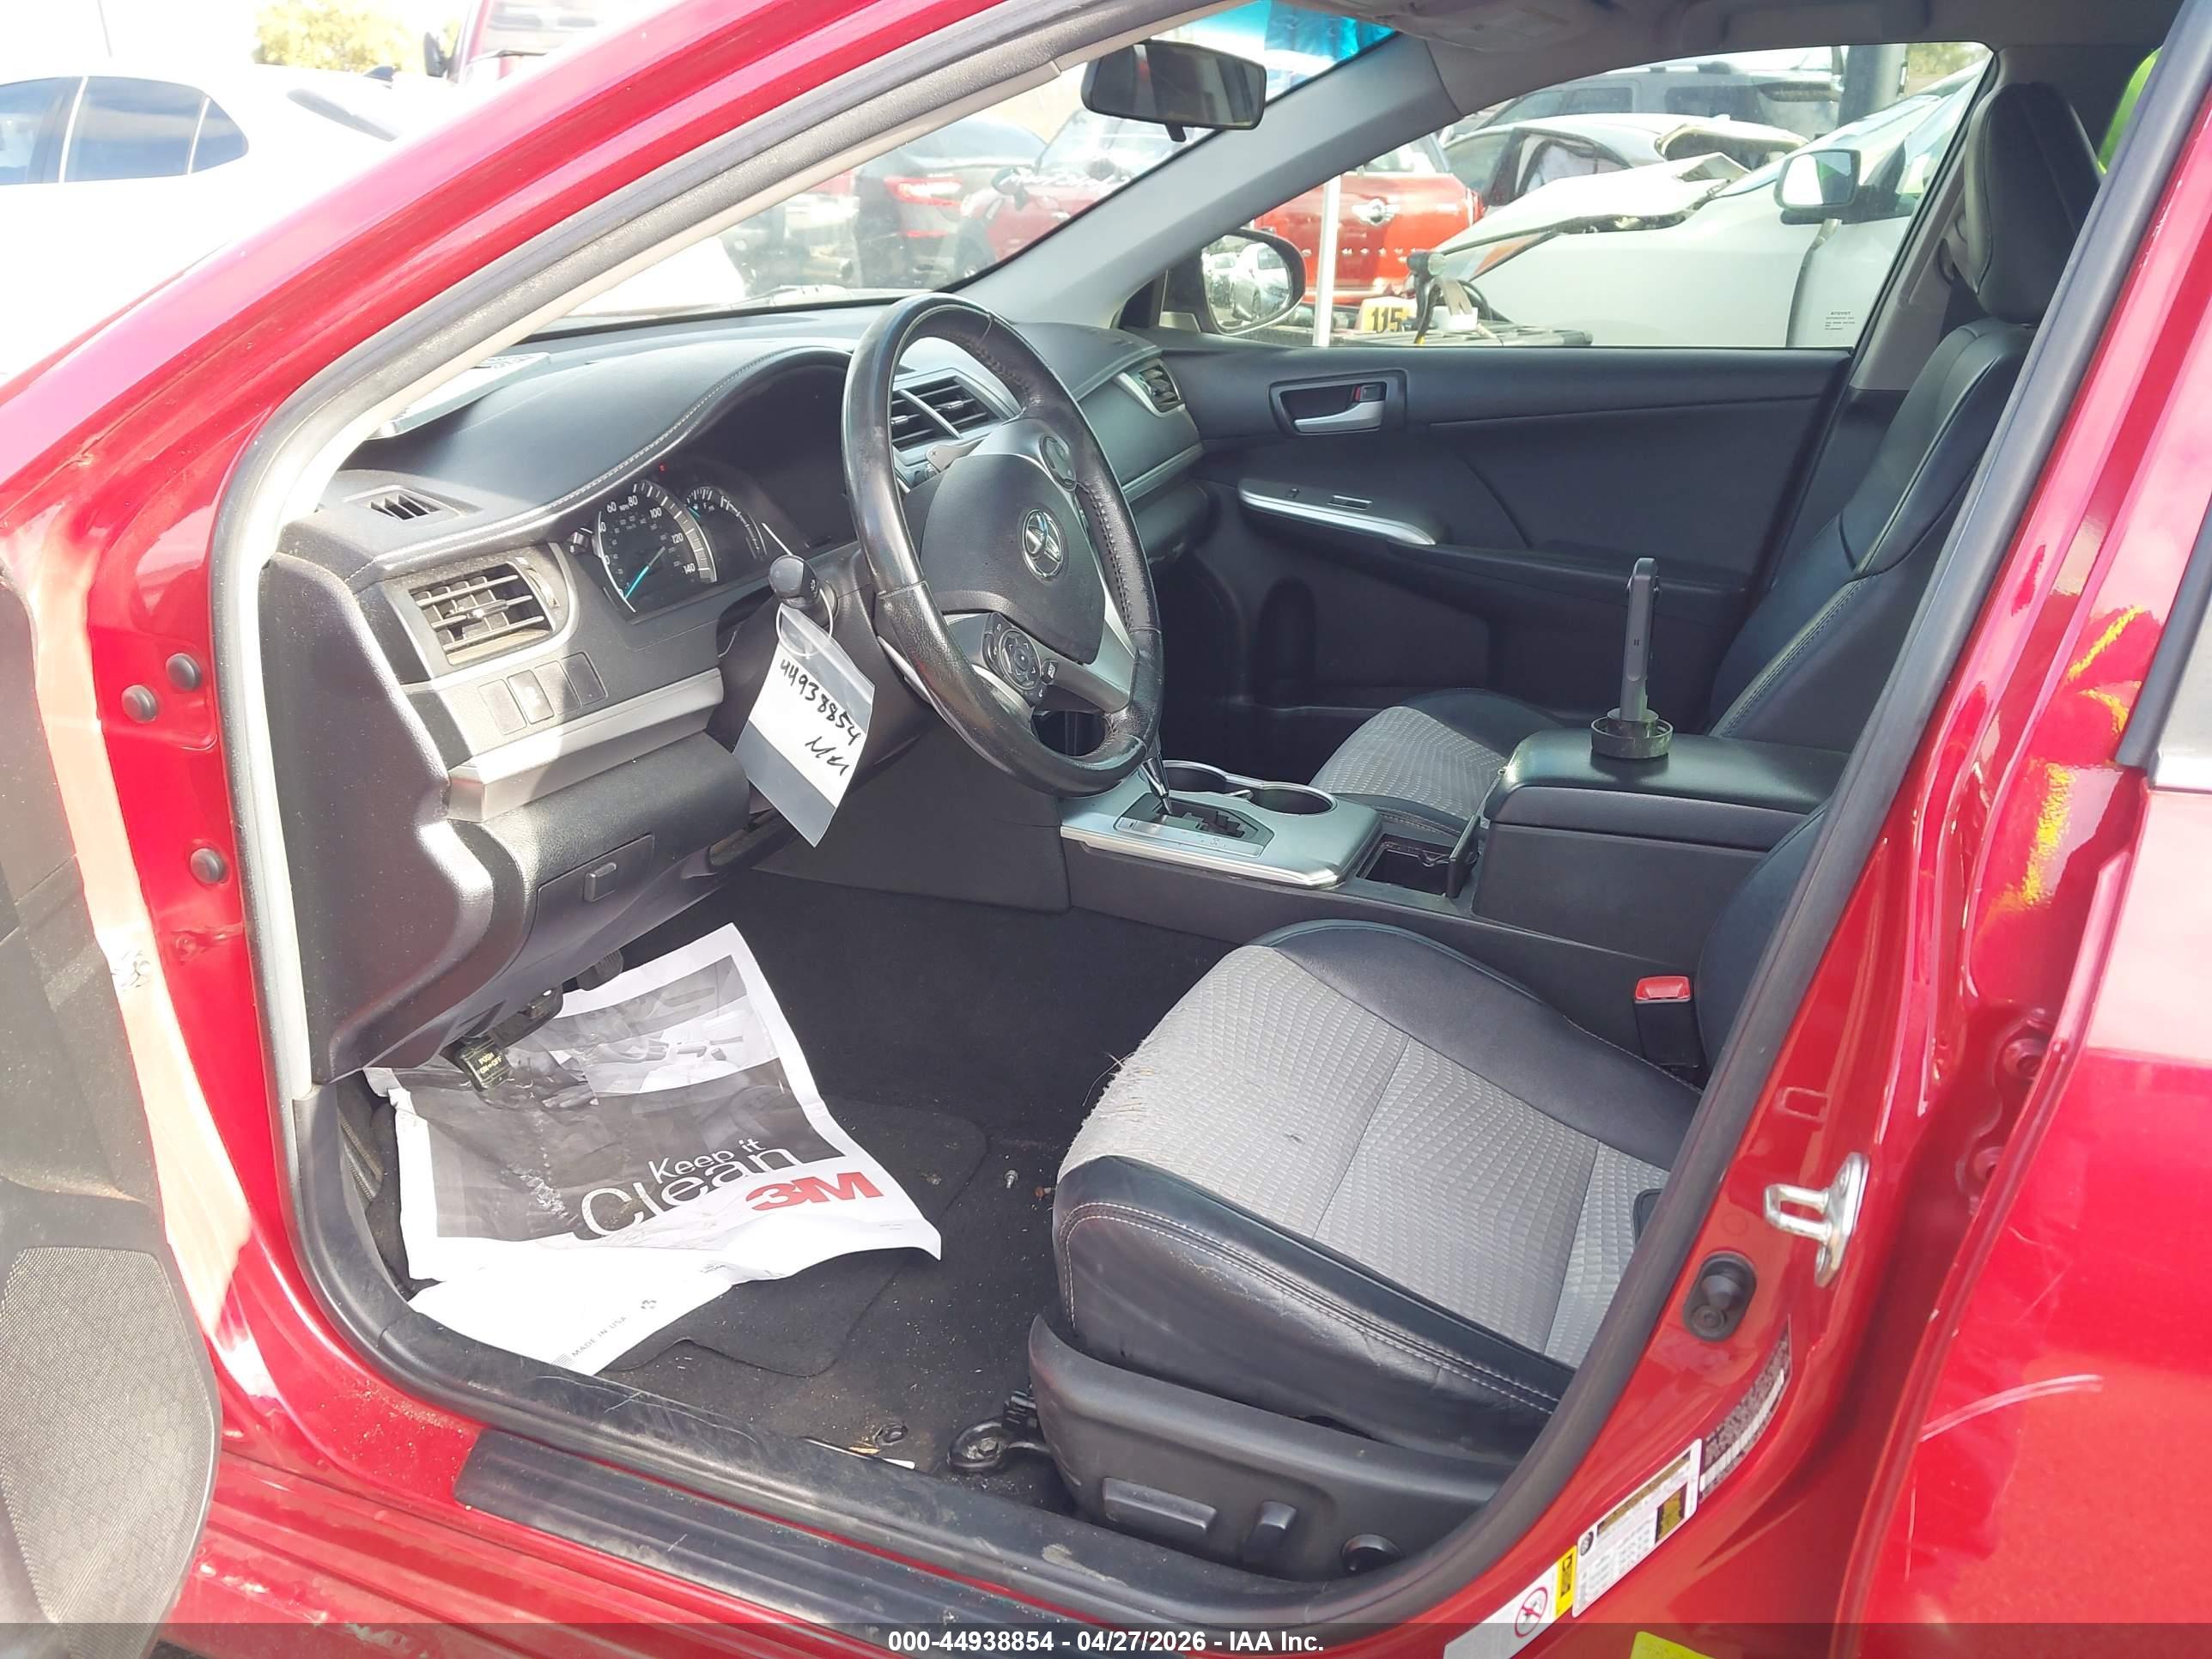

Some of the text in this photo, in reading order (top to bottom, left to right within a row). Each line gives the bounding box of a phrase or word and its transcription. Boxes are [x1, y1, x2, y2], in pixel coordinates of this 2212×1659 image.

[607, 502, 617, 513] 60
[628, 495, 638, 507] 80
[649, 507, 662, 520] 100
[672, 533, 684, 544] 120
[683, 563, 696, 574] 140
[781, 659, 861, 745] 44938854
[647, 1138, 766, 1184] Keep it
[580, 1147, 800, 1237] Clean
[745, 1171, 885, 1212] 3M
[572, 1316, 628, 1358] MADE IN USA
